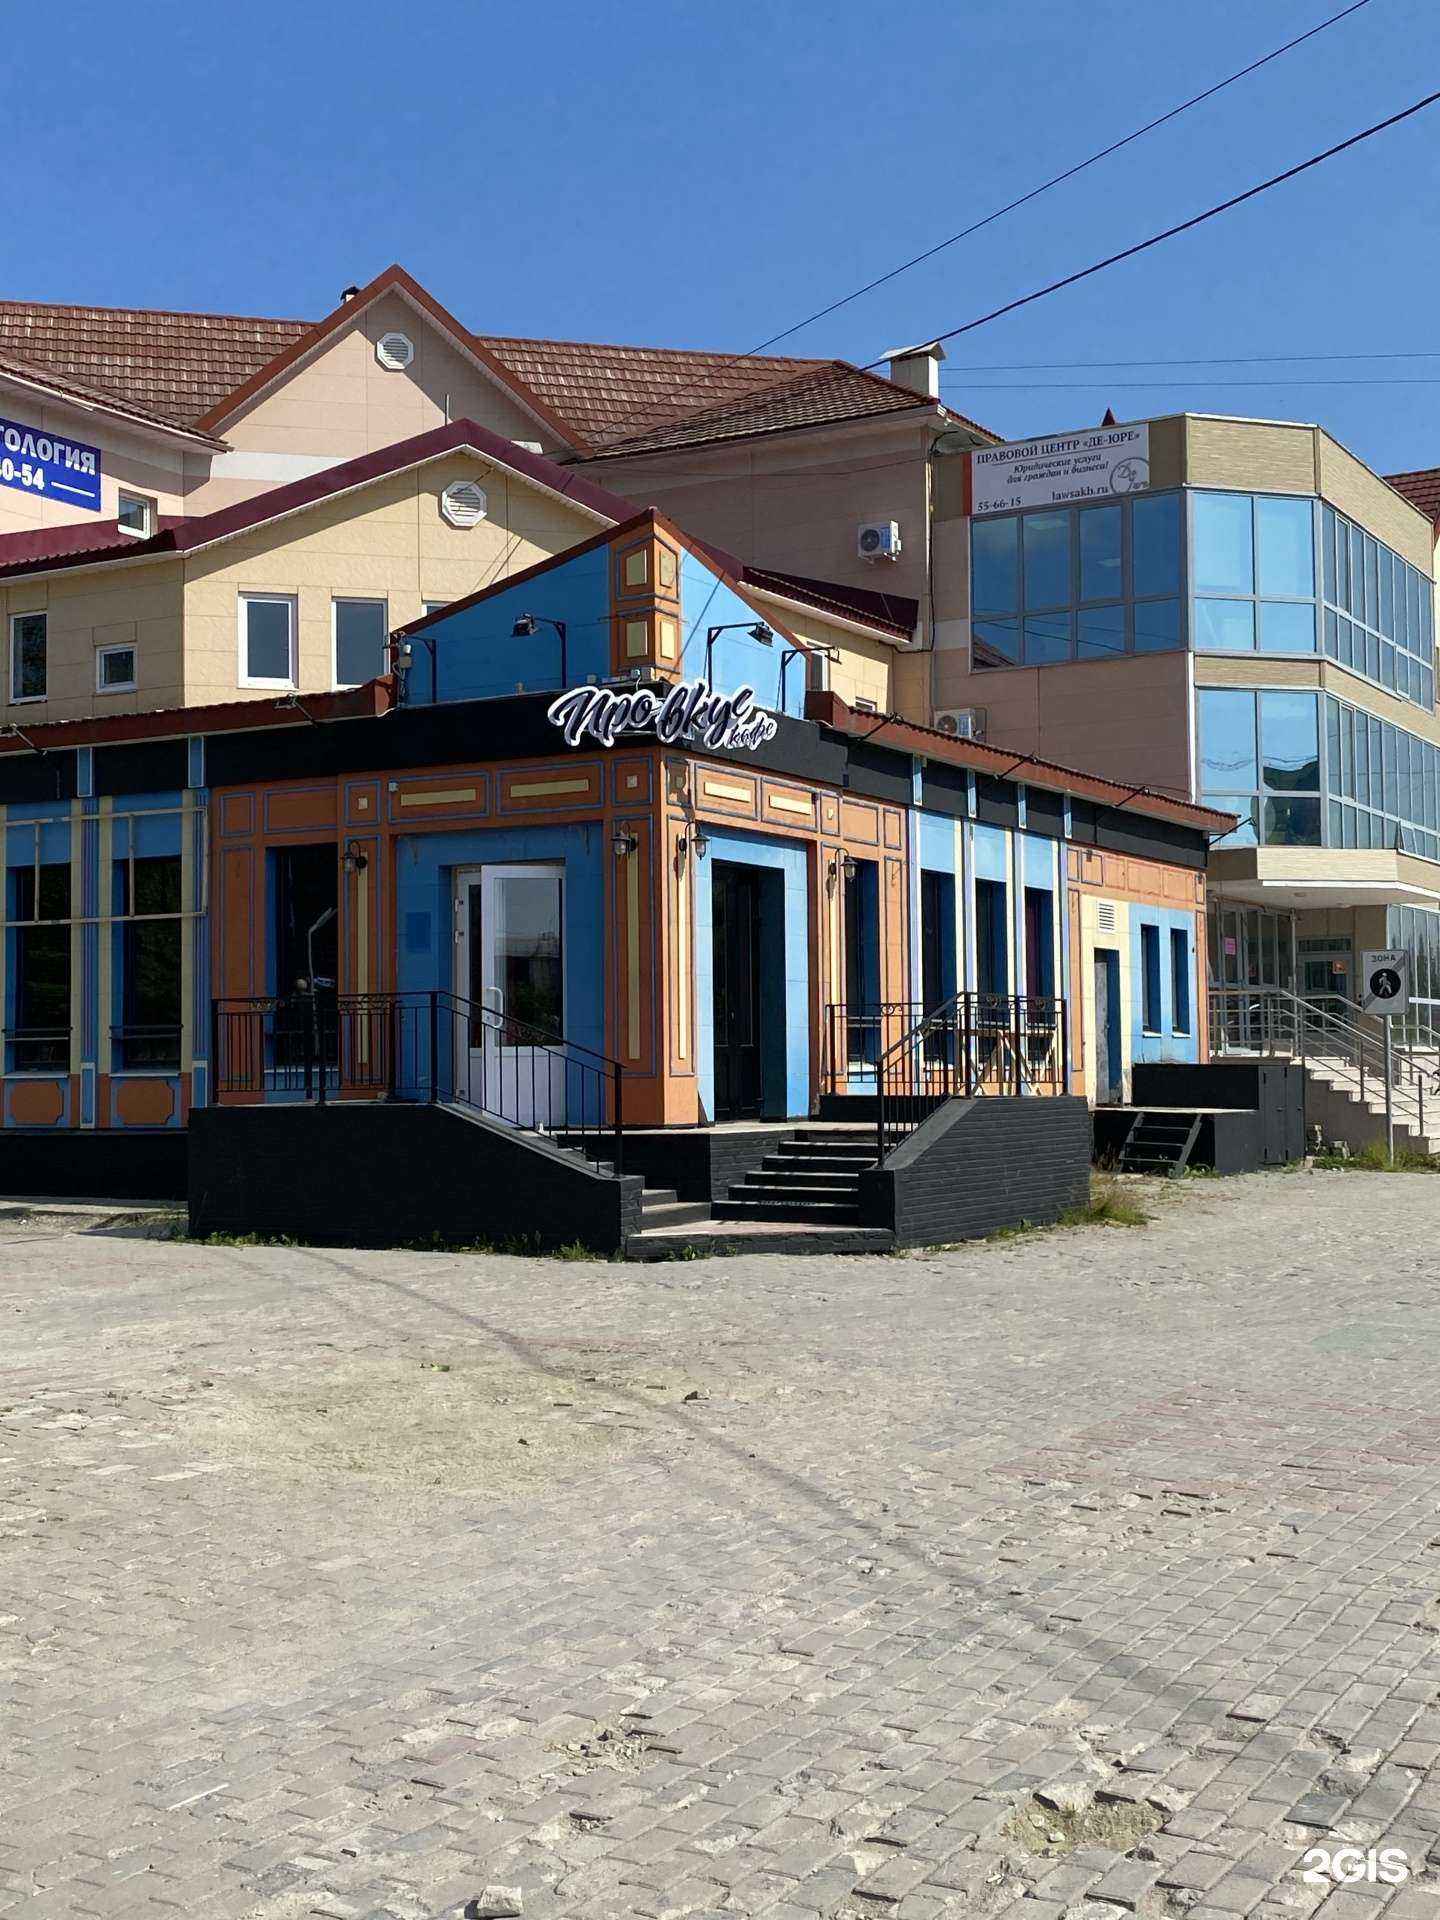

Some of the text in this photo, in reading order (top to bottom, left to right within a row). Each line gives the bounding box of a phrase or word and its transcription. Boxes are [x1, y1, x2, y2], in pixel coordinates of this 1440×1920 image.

[0, 425, 96, 475] ОЛОГИЯ
[977, 431, 1140, 463] ПРАВОВОЙ ЦЕНТР «ДЕ-ЮРЕ»
[0, 458, 45, 490] 0-54
[1007, 475, 1021, 484] для
[1023, 470, 1062, 482] граждан
[1071, 461, 1109, 474] бизнеса!
[1014, 454, 1101, 473] Юридические услуги
[977, 496, 1022, 512] 55-66-15
[1370, 954, 1397, 963] ЗОНА
